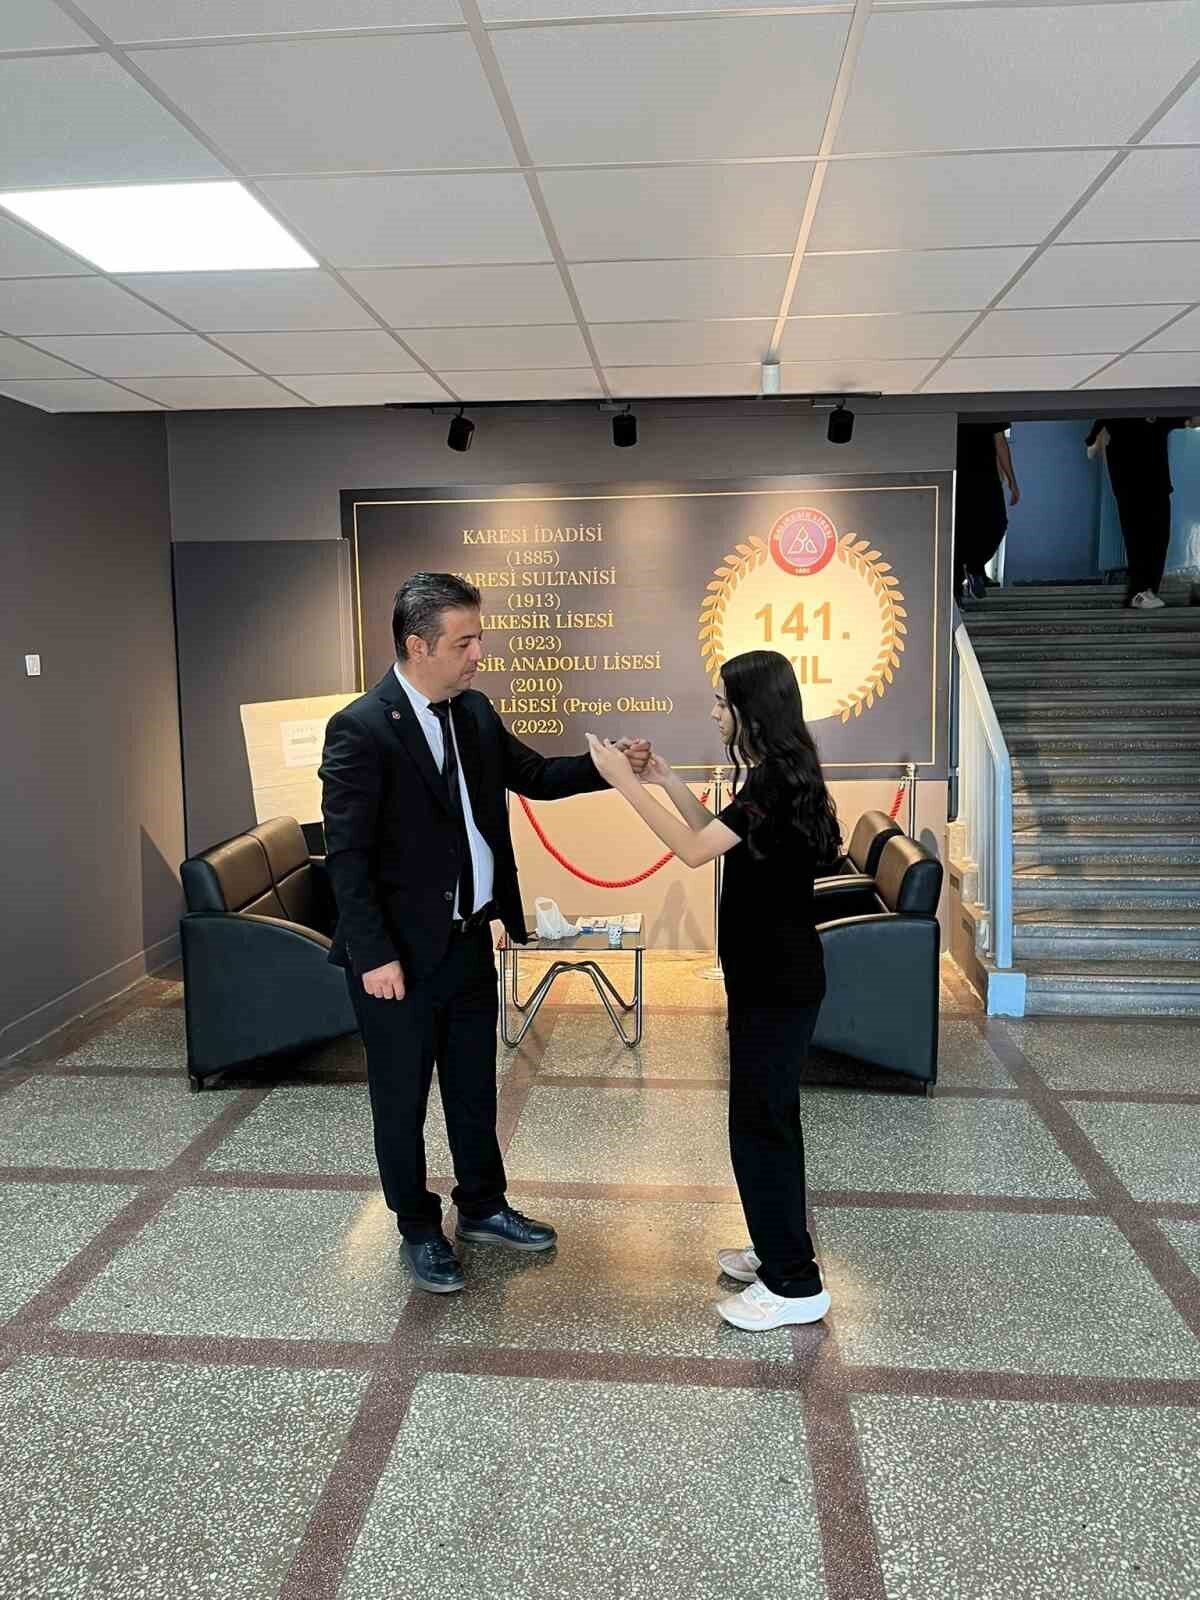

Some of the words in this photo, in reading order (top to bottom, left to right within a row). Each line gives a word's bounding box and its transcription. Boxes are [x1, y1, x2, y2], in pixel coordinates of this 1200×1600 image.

[535, 522, 604, 543] İDADİSİ
[506, 549, 560, 568] (1885)
[522, 566, 616, 586] SULTANİSİ
[507, 592, 561, 611] (1913)
[480, 610, 551, 630] LIKESİR
[556, 609, 615, 629] LİSESİ
[754, 601, 850, 642] 141.
[509, 634, 562, 653] (1923)
[510, 654, 598, 672] ANADOLU
[603, 650, 662, 671] LİSESİ
[790, 655, 832, 684] IL
[510, 676, 563, 696] (2010)
[500, 695, 558, 713] LİSESİ
[563, 697, 612, 716] (Proje
[616, 696, 673, 715] Okulu)
[511, 719, 564, 737] (2022)
